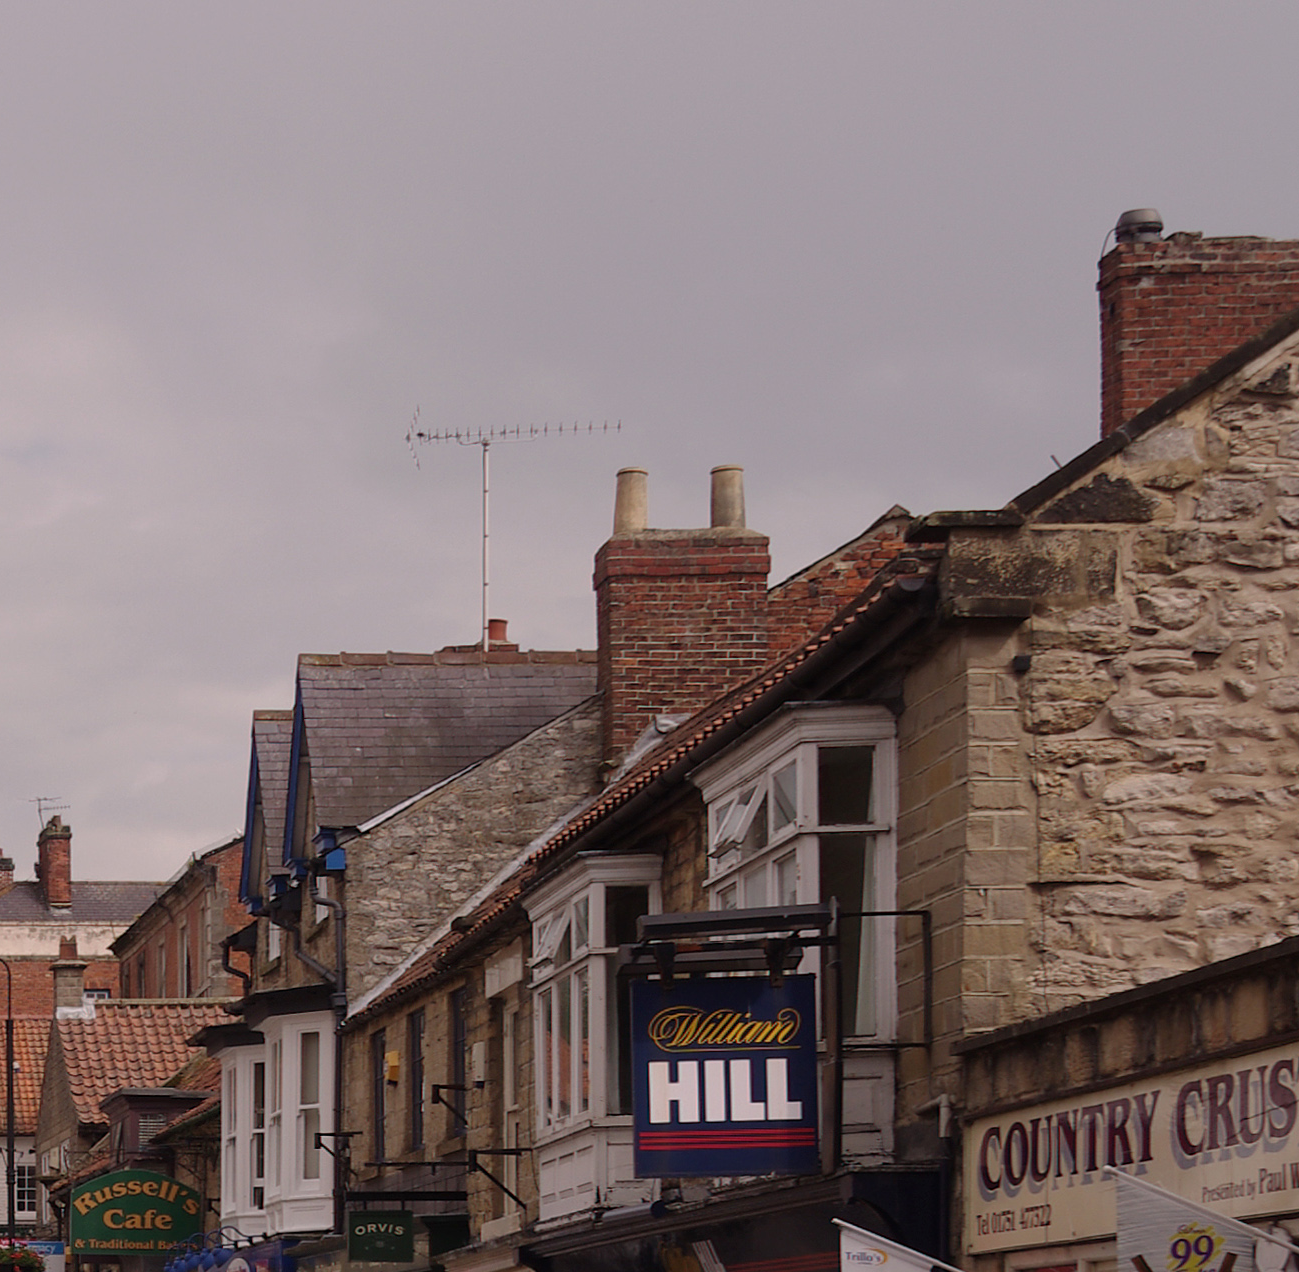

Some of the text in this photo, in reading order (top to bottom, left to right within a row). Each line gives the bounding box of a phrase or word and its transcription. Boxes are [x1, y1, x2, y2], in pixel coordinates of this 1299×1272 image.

[648, 1005, 801, 1053] William
[648, 1058, 803, 1124] HILL
[979, 1058, 1299, 1192] COUNTRY CRUS
[1259, 1163, 1288, 1194] Paul
[73, 1179, 200, 1217] Russell's
[103, 1208, 173, 1230] Cafe
[354, 1222, 406, 1237] ORVIS
[976, 1213, 990, 1236] Tel
[74, 1238, 85, 1249] &
[88, 1238, 154, 1250] Traditional
[1171, 1235, 1214, 1271] 99
